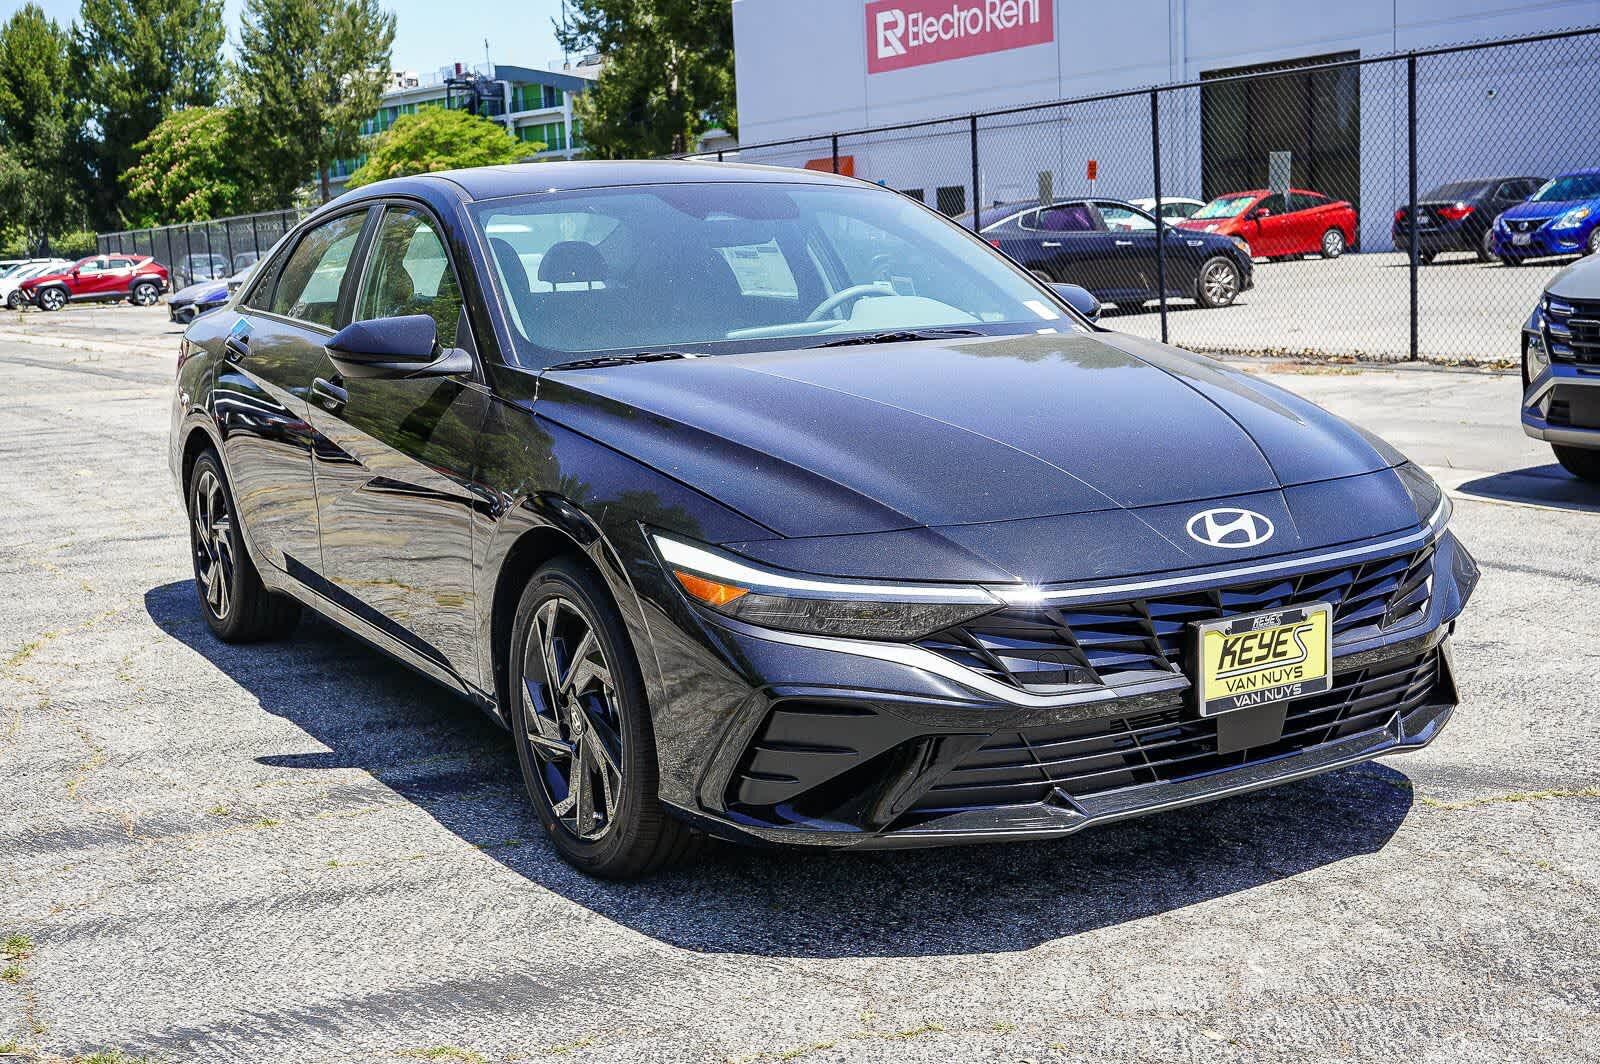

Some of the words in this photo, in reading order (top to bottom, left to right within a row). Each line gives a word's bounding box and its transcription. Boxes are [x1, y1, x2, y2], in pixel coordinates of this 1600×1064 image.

[908, 5, 983, 47] Electro
[1253, 613, 1283, 630] KEYES
[1217, 624, 1313, 674] KEYES
[1226, 674, 1257, 693] VAN
[1261, 666, 1303, 685] NUYS
[1234, 691, 1261, 708] VAN
[1265, 684, 1302, 702] NUYS
